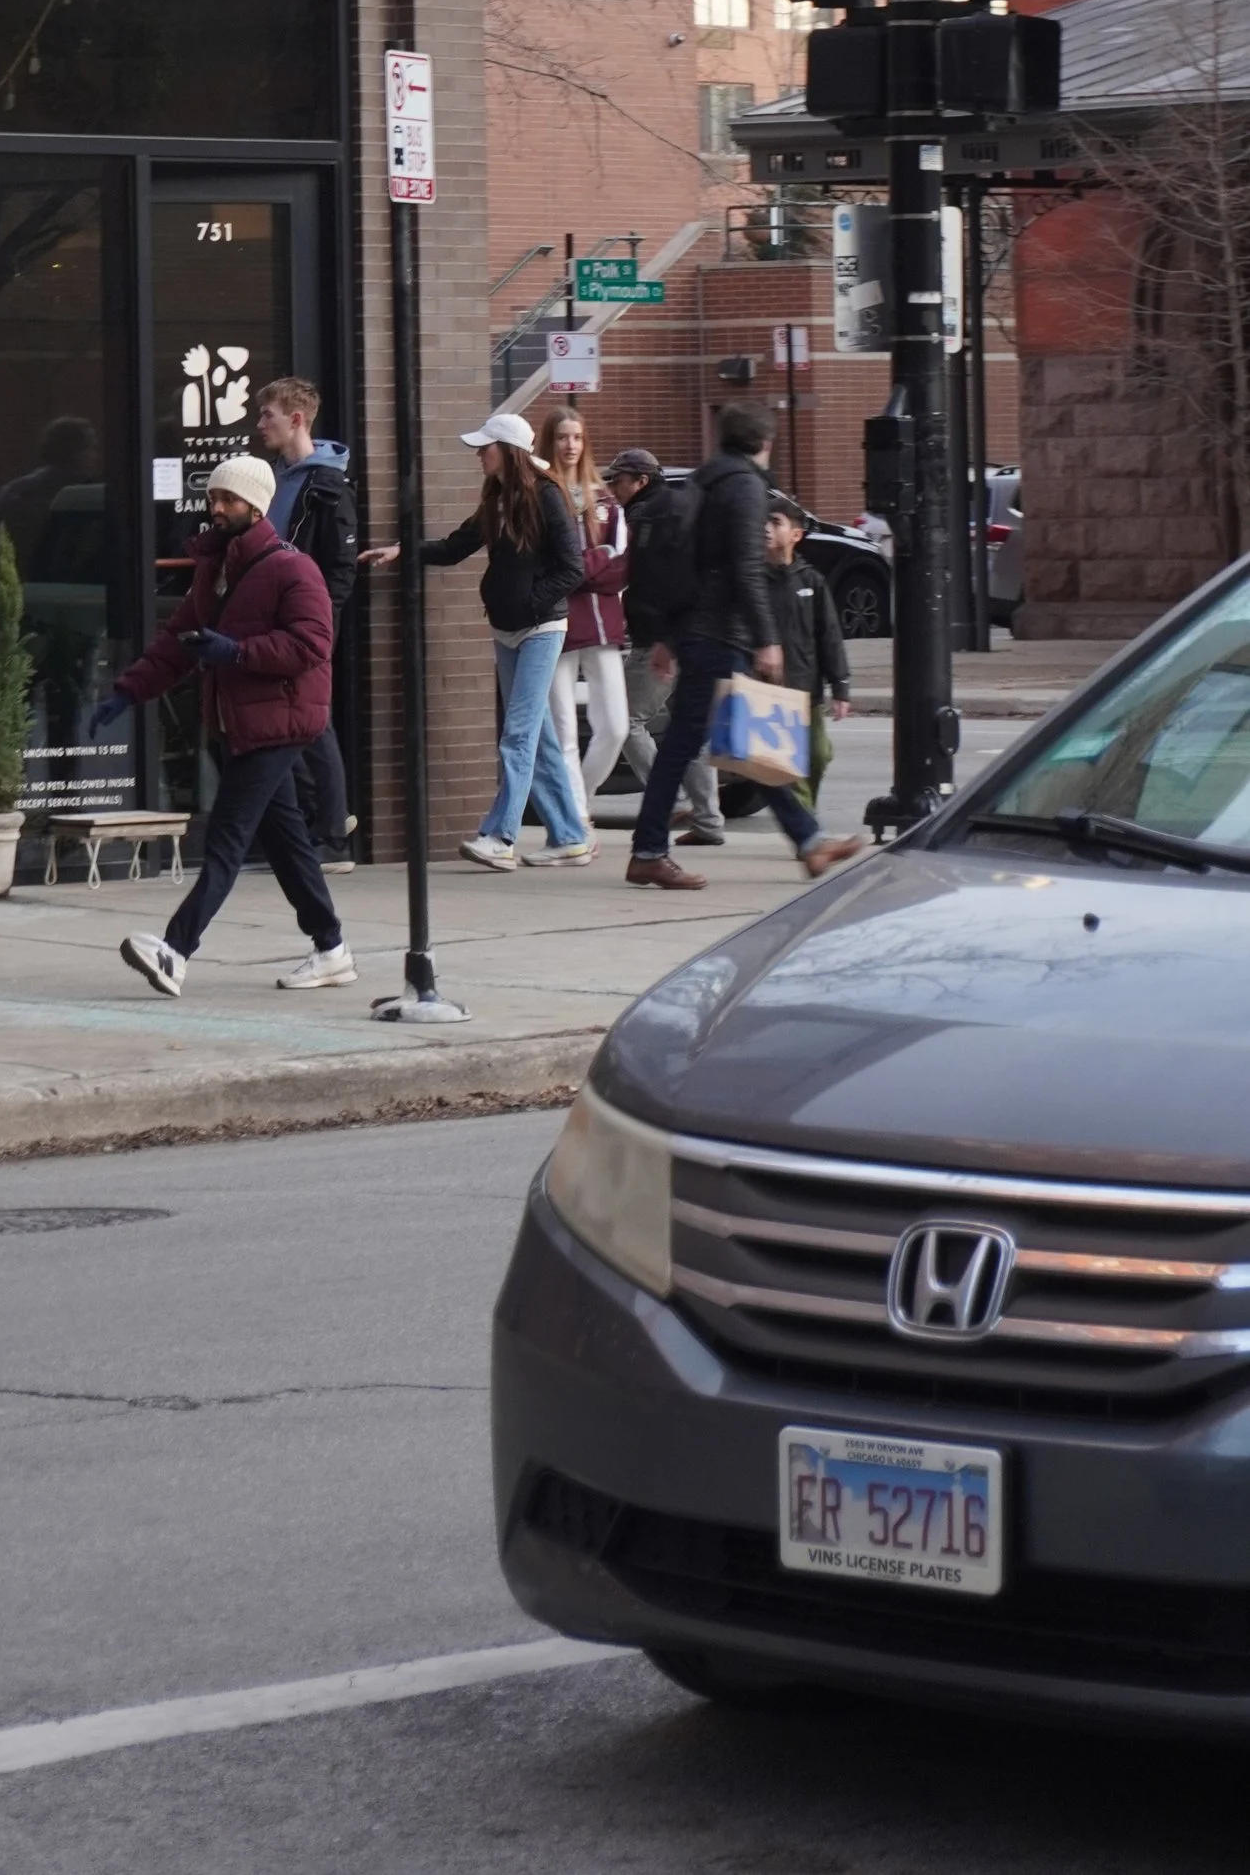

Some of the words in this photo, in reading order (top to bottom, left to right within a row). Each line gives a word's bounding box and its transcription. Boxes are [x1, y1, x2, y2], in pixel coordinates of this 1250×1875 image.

[197, 222, 232, 242] 751
[592, 262, 620, 278] Polk
[588, 282, 650, 301] Plymouth
[183, 435, 250, 447] TOTTO'S
[174, 498, 207, 513] 8AM
[23, 747, 64, 758] SMOKING
[65, 746, 97, 756] WITHIN
[109, 744, 128, 754] FEET
[31, 781, 46, 791] NO
[47, 780, 66, 791] PETS
[67, 779, 106, 790] ALLOWED
[107, 777, 135, 787] INSIDE
[47, 797, 81, 807] SERVICE
[82, 794, 123, 806] ANIMALS)
[866, 1441, 875, 1450] W
[877, 1443, 906, 1454] DEVON
[908, 1446, 924, 1456] AVE
[847, 1451, 885, 1464] CHICAGO
[887, 1456, 894, 1465] IL
[797, 1474, 841, 1542] FR
[868, 1482, 985, 1558] 52716
[808, 1548, 842, 1567] VINS
[846, 1553, 906, 1576] LICENSE
[909, 1562, 962, 1584] PLATES
